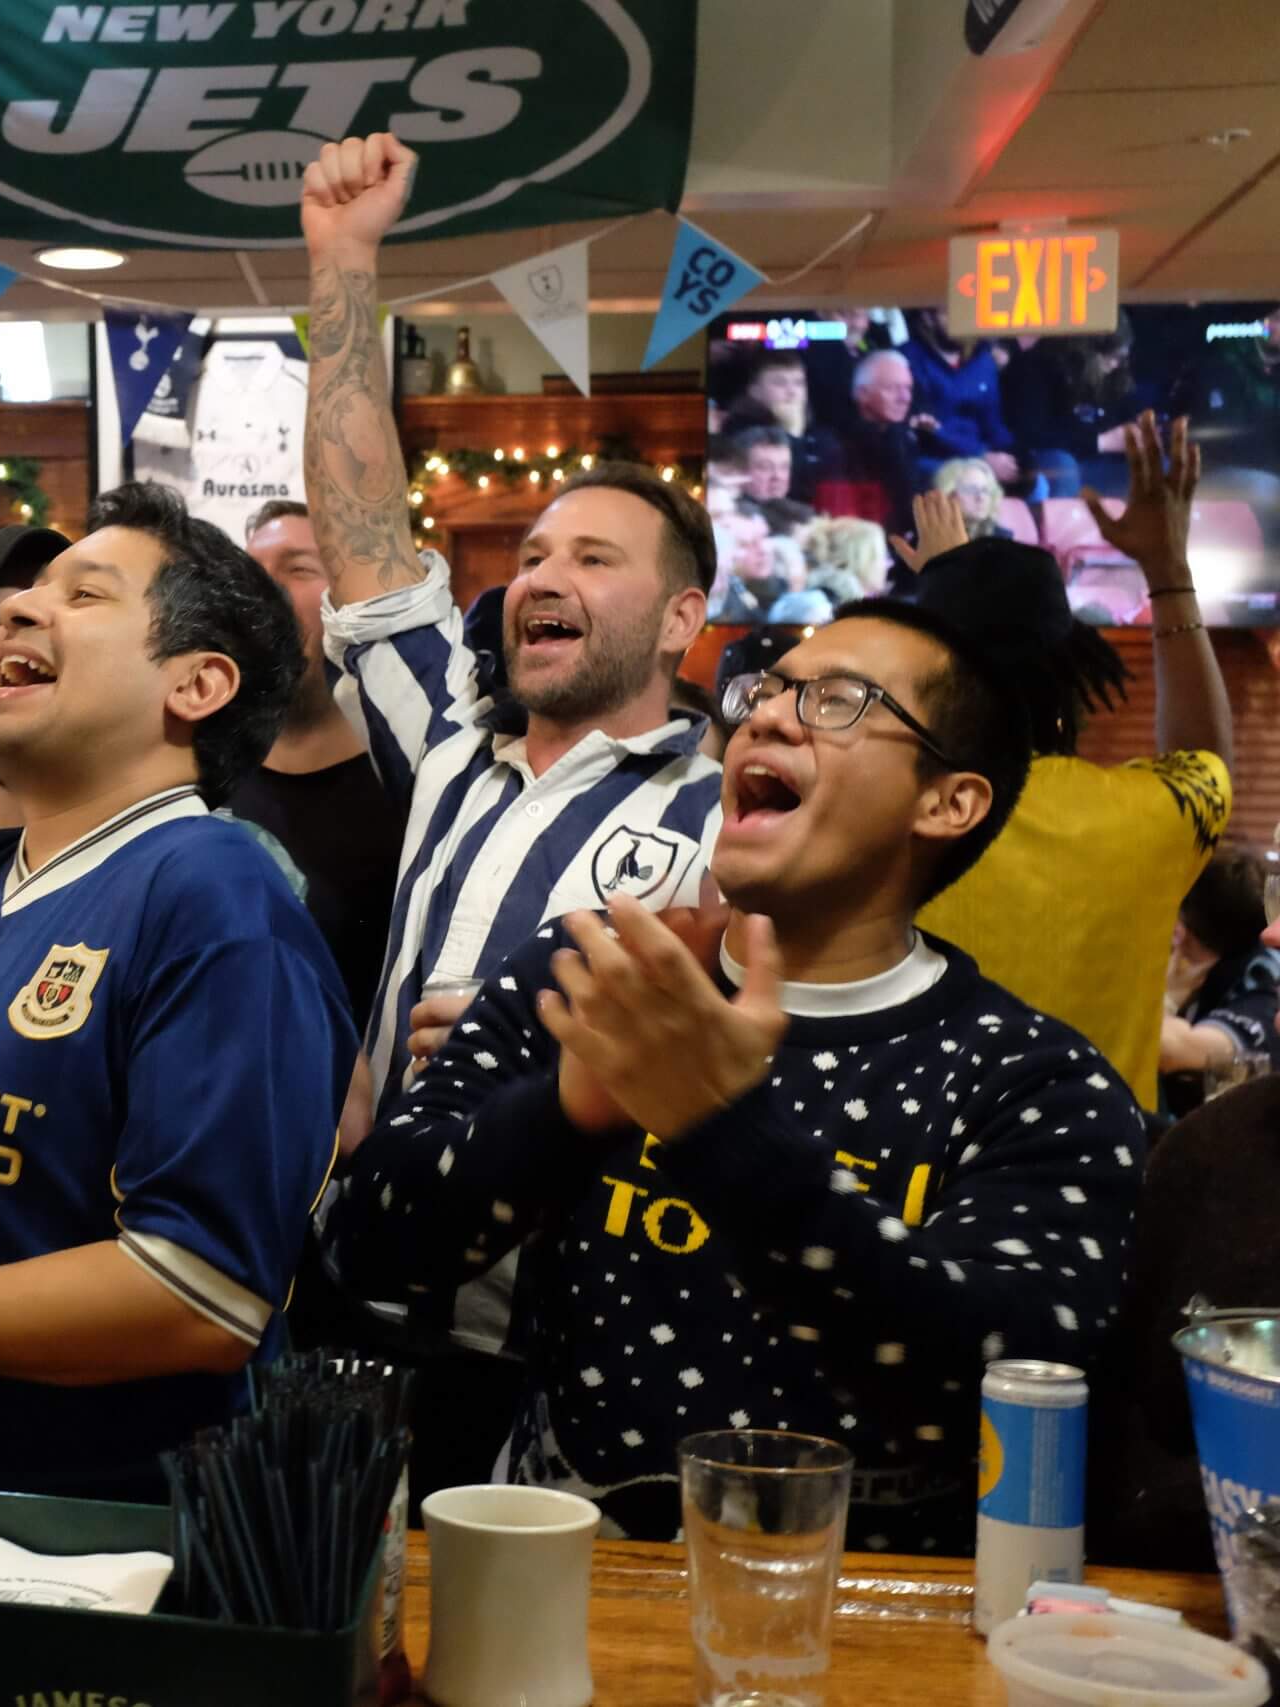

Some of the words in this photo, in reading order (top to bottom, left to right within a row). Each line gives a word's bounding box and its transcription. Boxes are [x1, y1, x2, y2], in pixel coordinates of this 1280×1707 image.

[42, 3, 236, 43] NEW
[240, 0, 472, 39] YORK
[1, 47, 543, 154] JETS
[688, 247, 735, 288] CO
[976, 236, 1097, 328] EXIT
[674, 269, 720, 316] YS
[203, 478, 290, 497] Aurasma
[601, 1175, 711, 1254] TO
